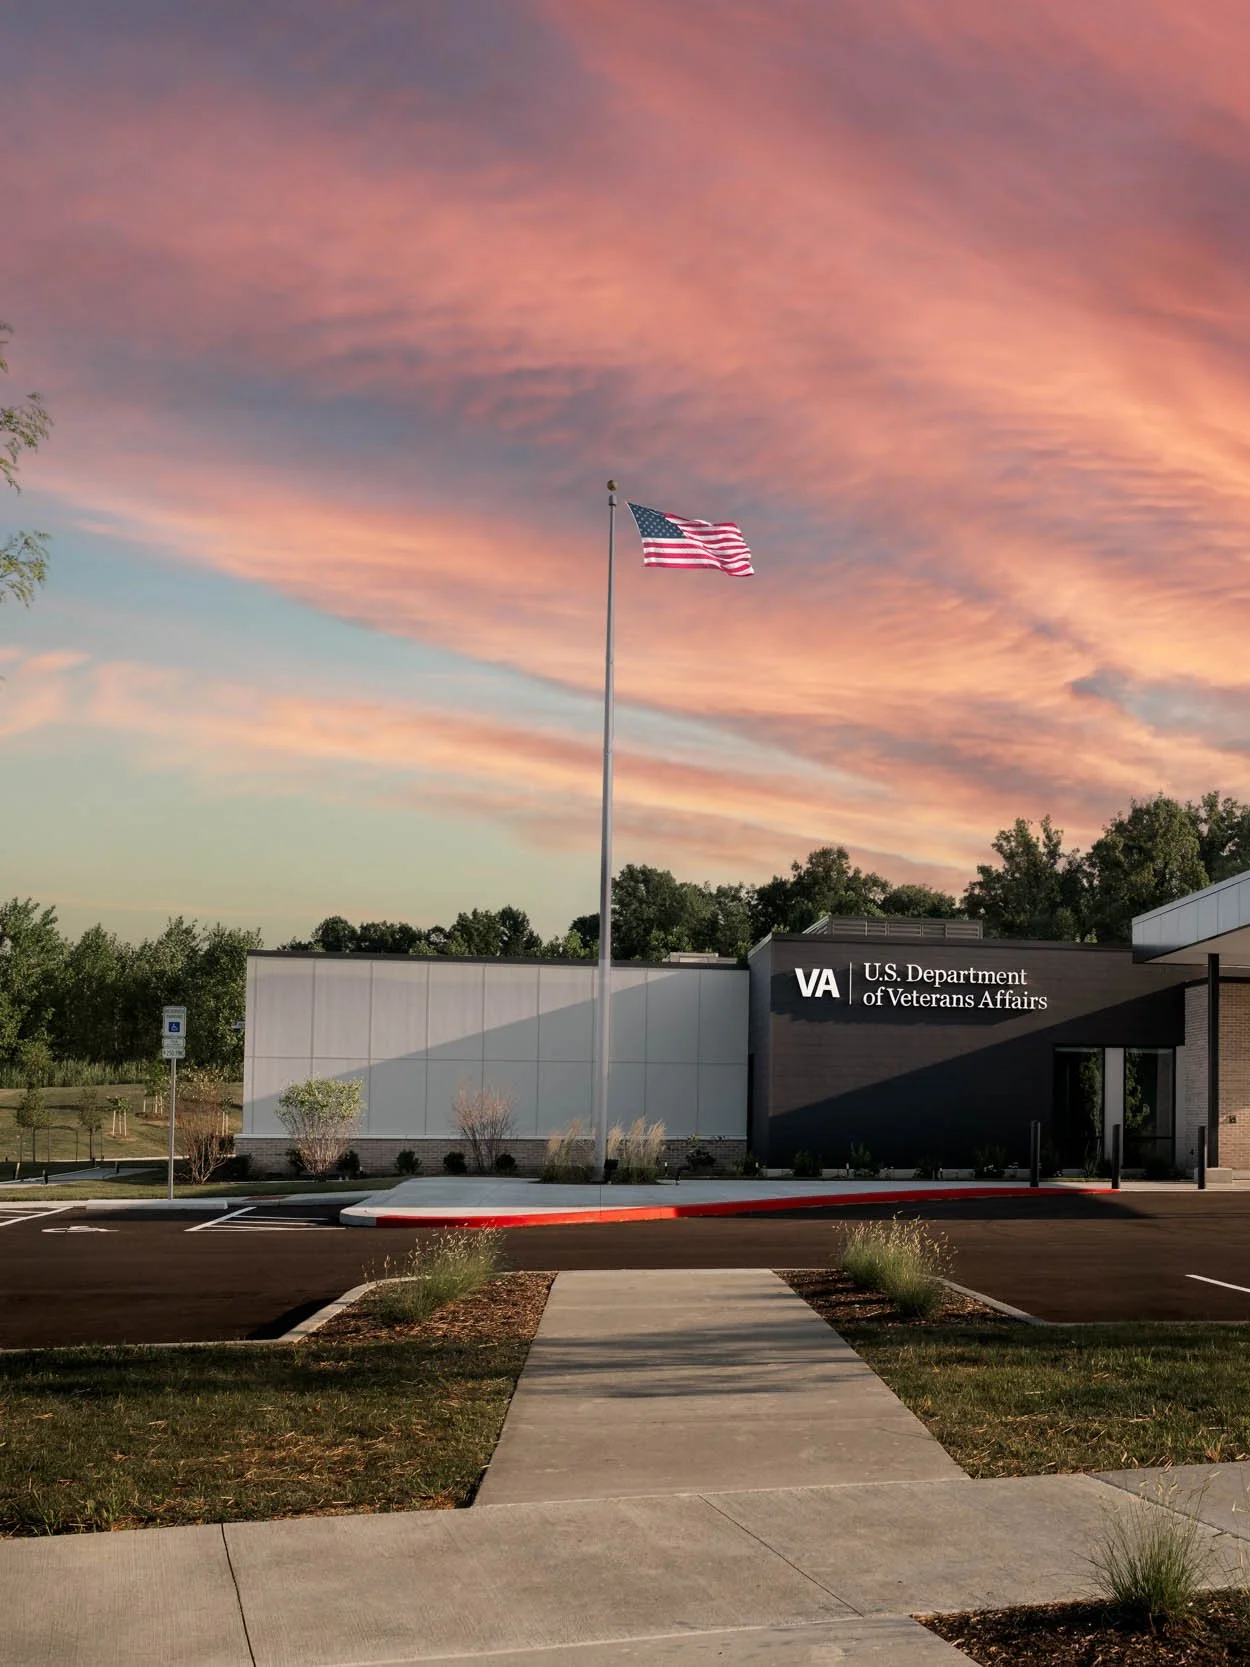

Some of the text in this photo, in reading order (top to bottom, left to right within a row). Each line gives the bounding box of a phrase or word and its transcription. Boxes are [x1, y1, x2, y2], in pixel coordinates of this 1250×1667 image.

[795, 967, 841, 998] VA
[864, 962, 1028, 988] U.S. Department
[863, 986, 1048, 1010] of Veterans Affairs
